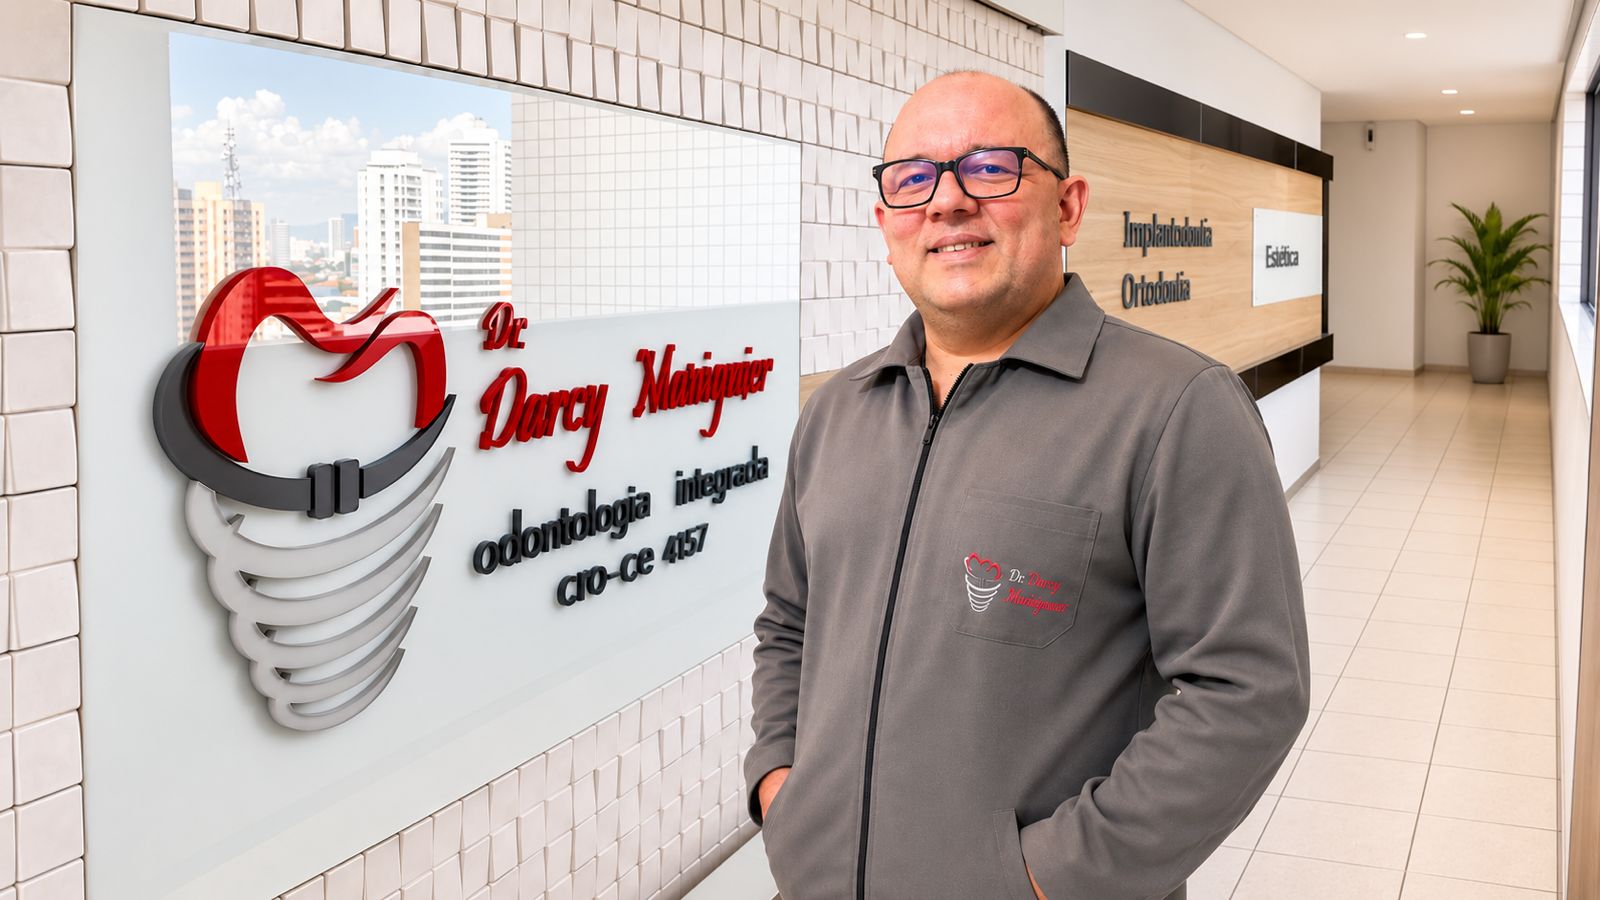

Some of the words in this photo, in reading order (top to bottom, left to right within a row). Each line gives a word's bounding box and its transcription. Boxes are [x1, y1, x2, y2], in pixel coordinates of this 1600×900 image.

[1123, 210, 1213, 257] Implantodontia
[1266, 245, 1299, 268] Estética
[1121, 271, 1190, 310] Ortodontia
[479, 367, 608, 473] Darcy
[473, 486, 651, 575] odontologia
[675, 445, 769, 506] integrada
[556, 547, 655, 607] cro-ce
[662, 523, 709, 564] 4157
[1008, 568, 1025, 584] Dr.
[1027, 571, 1062, 596] Darcy
